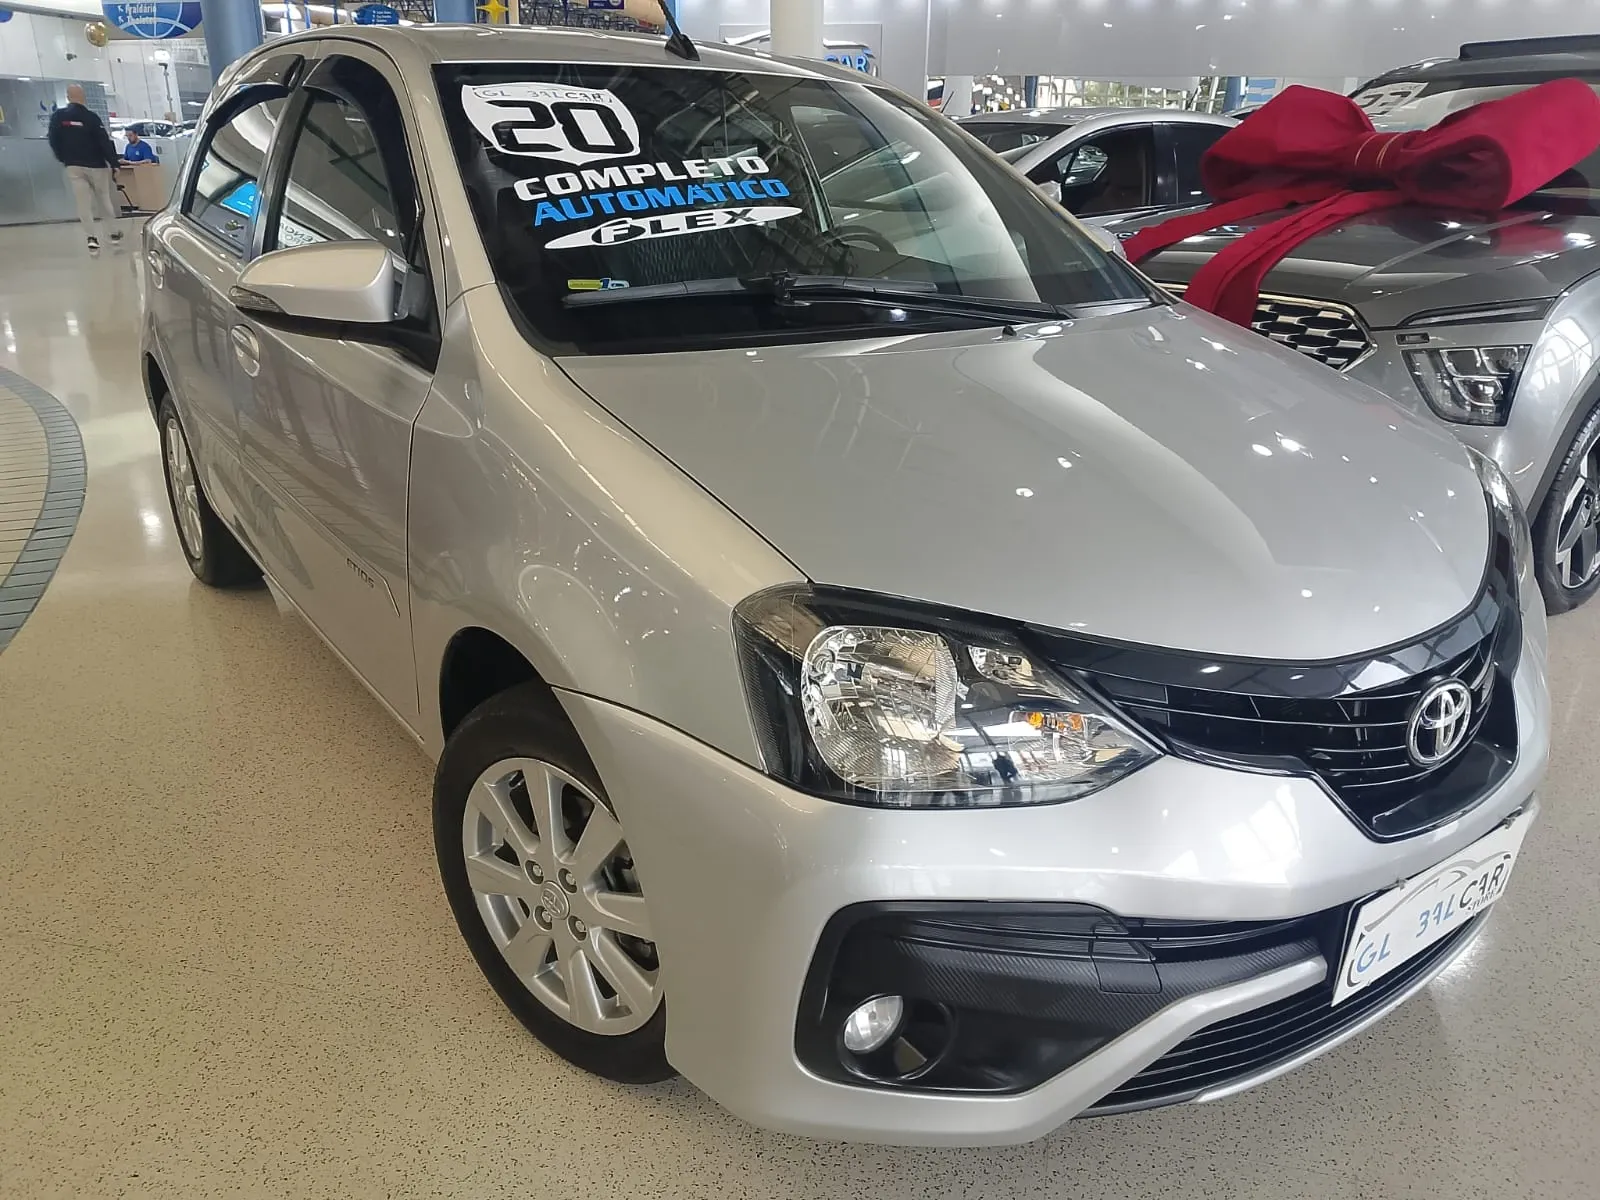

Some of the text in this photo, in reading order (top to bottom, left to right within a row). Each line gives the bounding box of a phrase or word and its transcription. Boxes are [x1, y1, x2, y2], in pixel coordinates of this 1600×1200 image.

[485, 99, 635, 154] 20
[513, 156, 770, 202] COMPLETO
[533, 178, 791, 227] AUTOMÁTICO
[600, 208, 760, 244] FLEX
